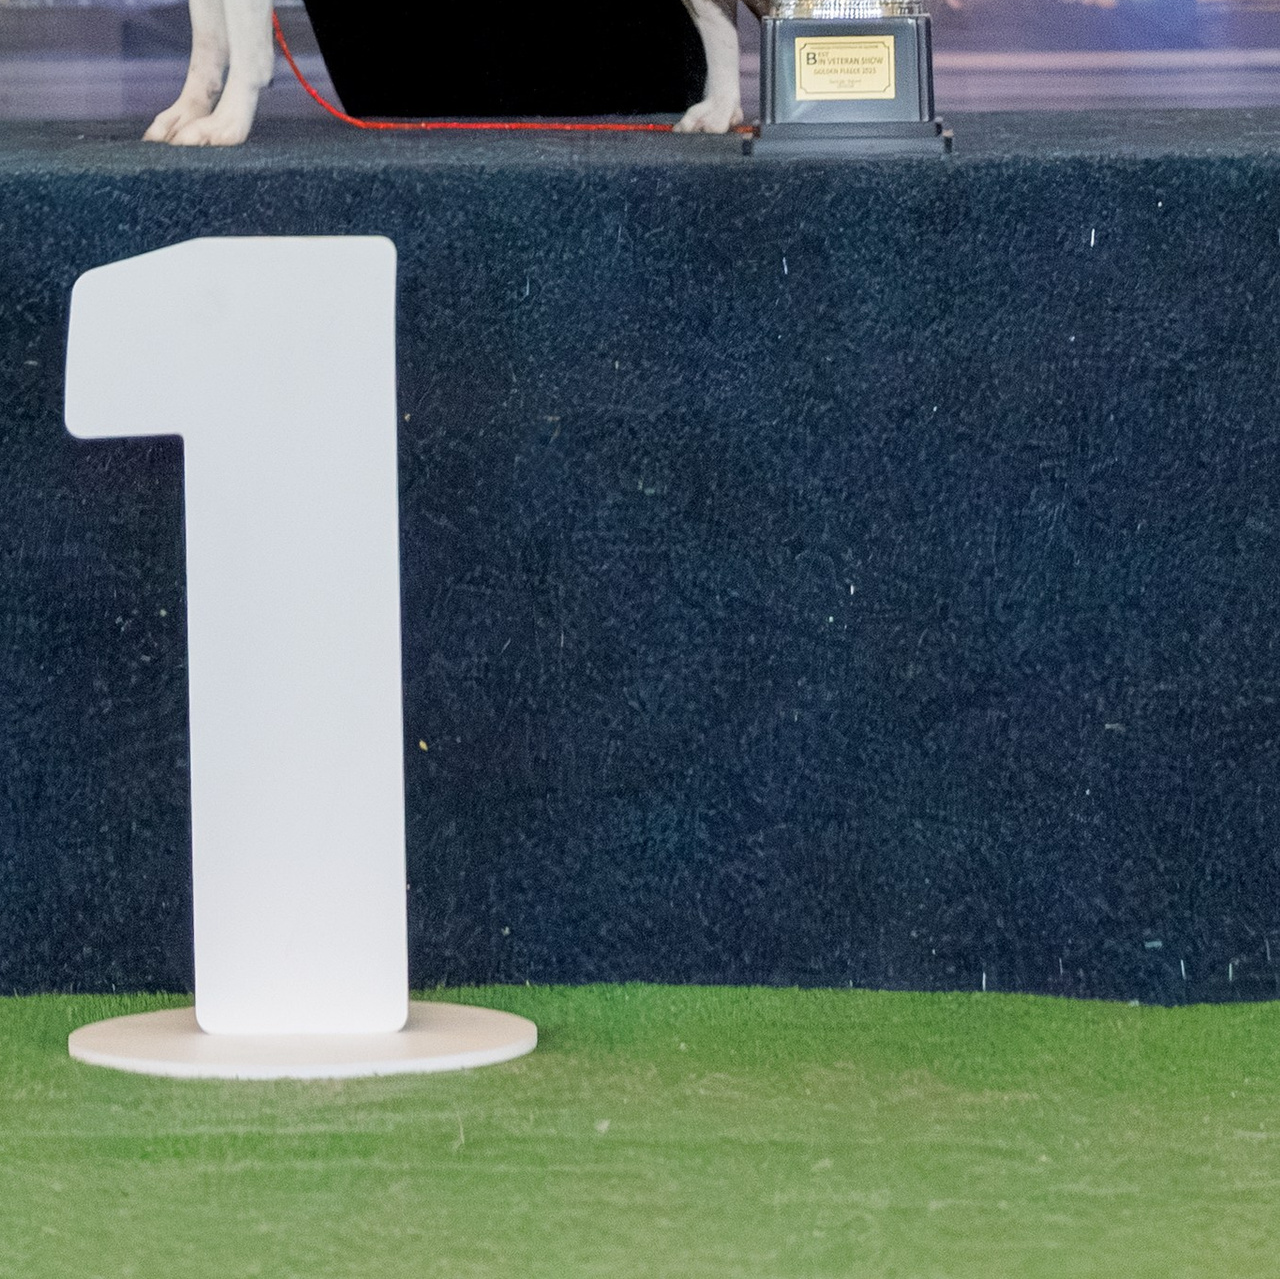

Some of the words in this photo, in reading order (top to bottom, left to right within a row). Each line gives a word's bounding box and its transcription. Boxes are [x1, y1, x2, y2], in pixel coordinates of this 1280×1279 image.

[827, 56, 860, 65] VETERAN
[861, 56, 884, 65] SHOW
[65, 235, 408, 1034] 1
